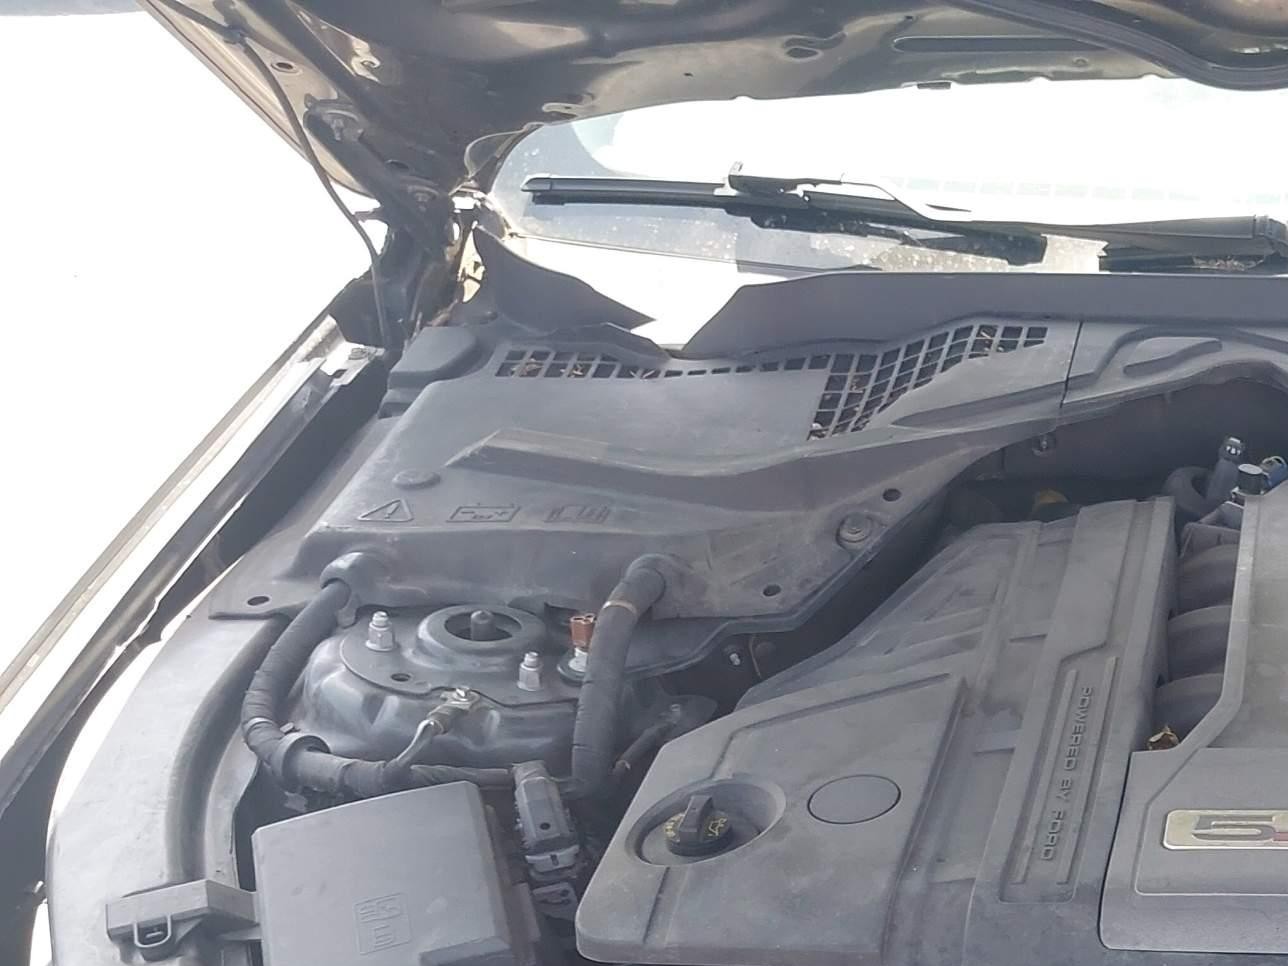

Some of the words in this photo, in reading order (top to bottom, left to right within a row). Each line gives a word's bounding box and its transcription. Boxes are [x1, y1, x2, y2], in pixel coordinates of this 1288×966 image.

[1064, 686, 1094, 771] POWERED
[1056, 778, 1073, 803] BY
[1041, 809, 1067, 861] FORD
